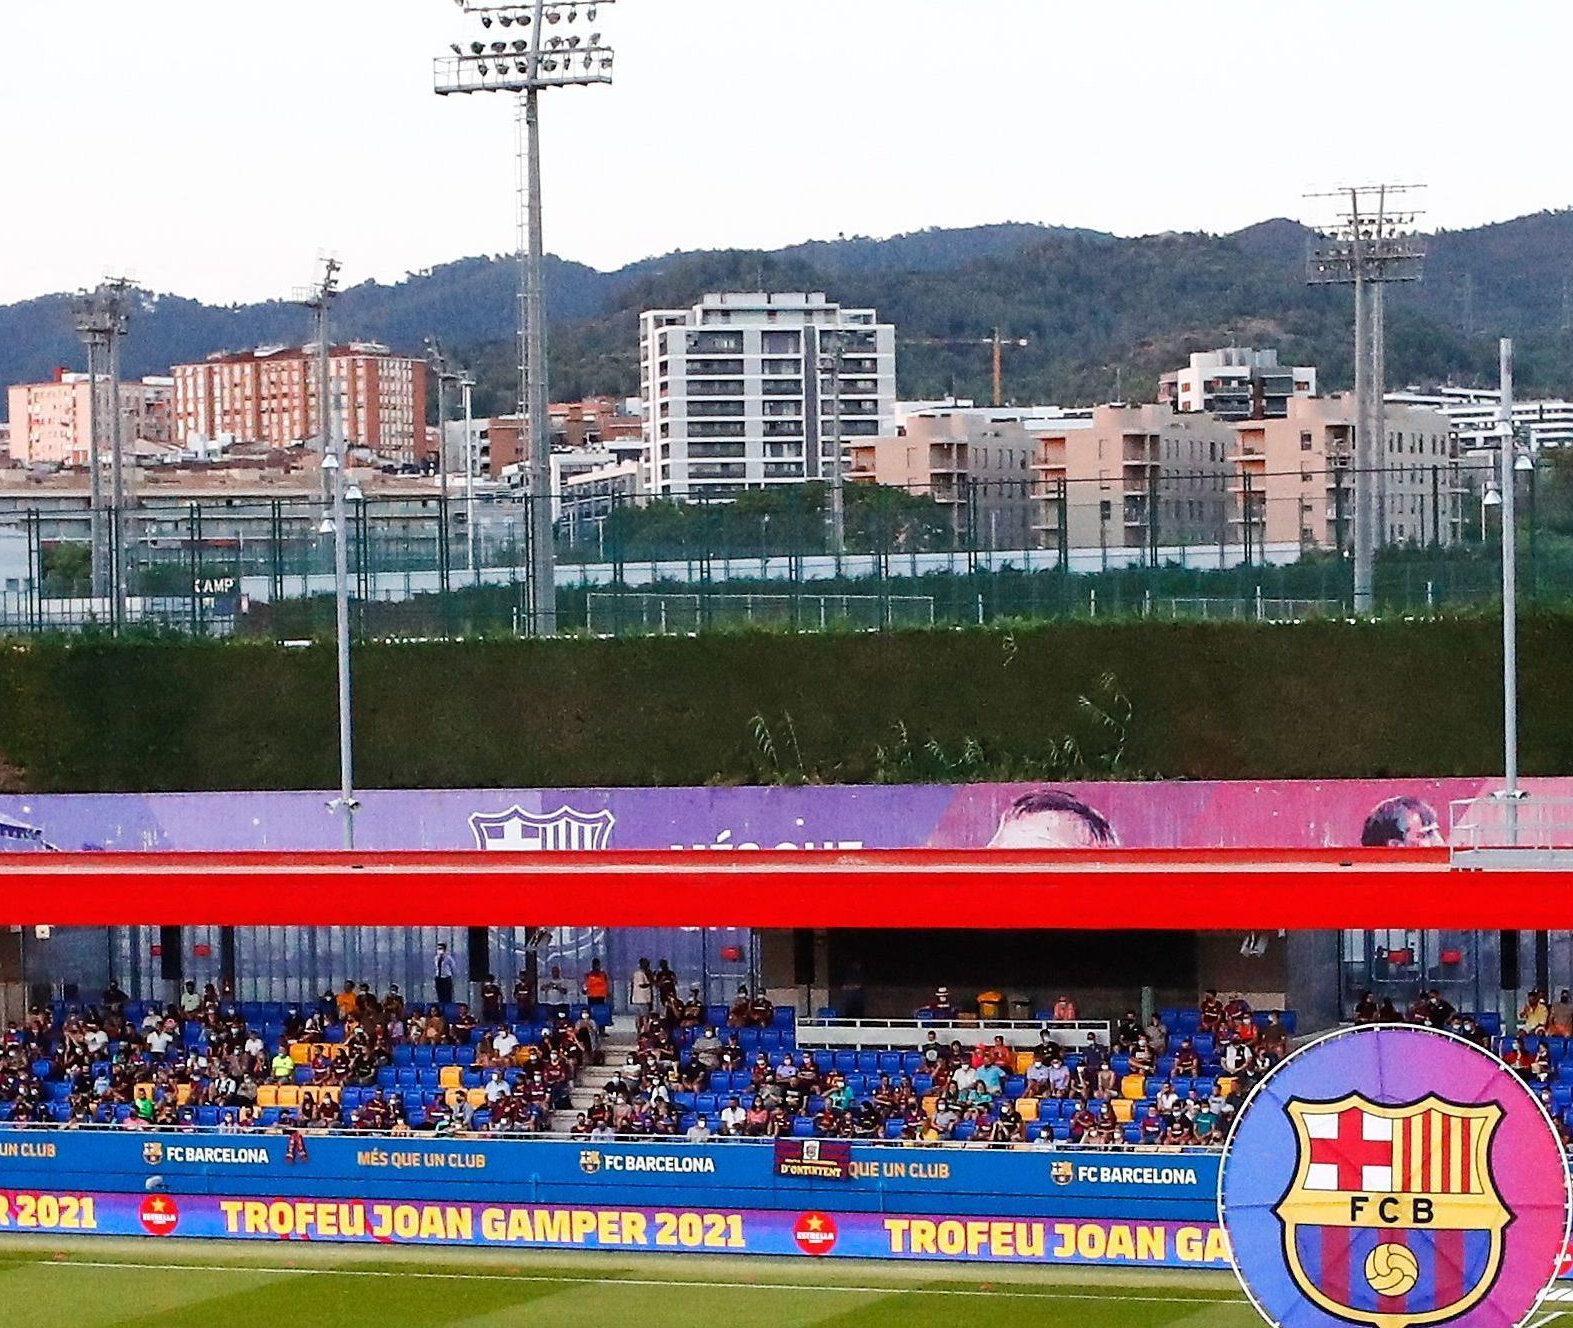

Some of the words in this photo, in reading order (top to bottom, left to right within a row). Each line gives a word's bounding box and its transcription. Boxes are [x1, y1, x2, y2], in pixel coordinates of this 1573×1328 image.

[21, 1142, 56, 1158] CLUB
[167, 1146, 185, 1162] FC
[186, 1147, 269, 1164] BARCELONA
[357, 1148, 389, 1167] MÉS
[392, 1151, 422, 1169] QUE
[424, 1152, 445, 1167] UN
[448, 1152, 485, 1168] CLUB
[604, 1154, 623, 1171] FC
[625, 1155, 715, 1173] BARCELONA
[848, 1161, 881, 1181] QUE
[884, 1162, 905, 1178] UN
[909, 1162, 950, 1179] CLUB
[1078, 1165, 1099, 1182] FC
[1101, 1166, 1197, 1185] BARCELONA
[16, 1195, 97, 1229] 2021
[220, 1200, 366, 1237] TROFEU
[372, 1204, 472, 1240] JOAN
[481, 1207, 646, 1245] GAMPER
[655, 1212, 746, 1248] 2021
[884, 1218, 1045, 1258] TROFEU
[1053, 1223, 1170, 1261] JOAN
